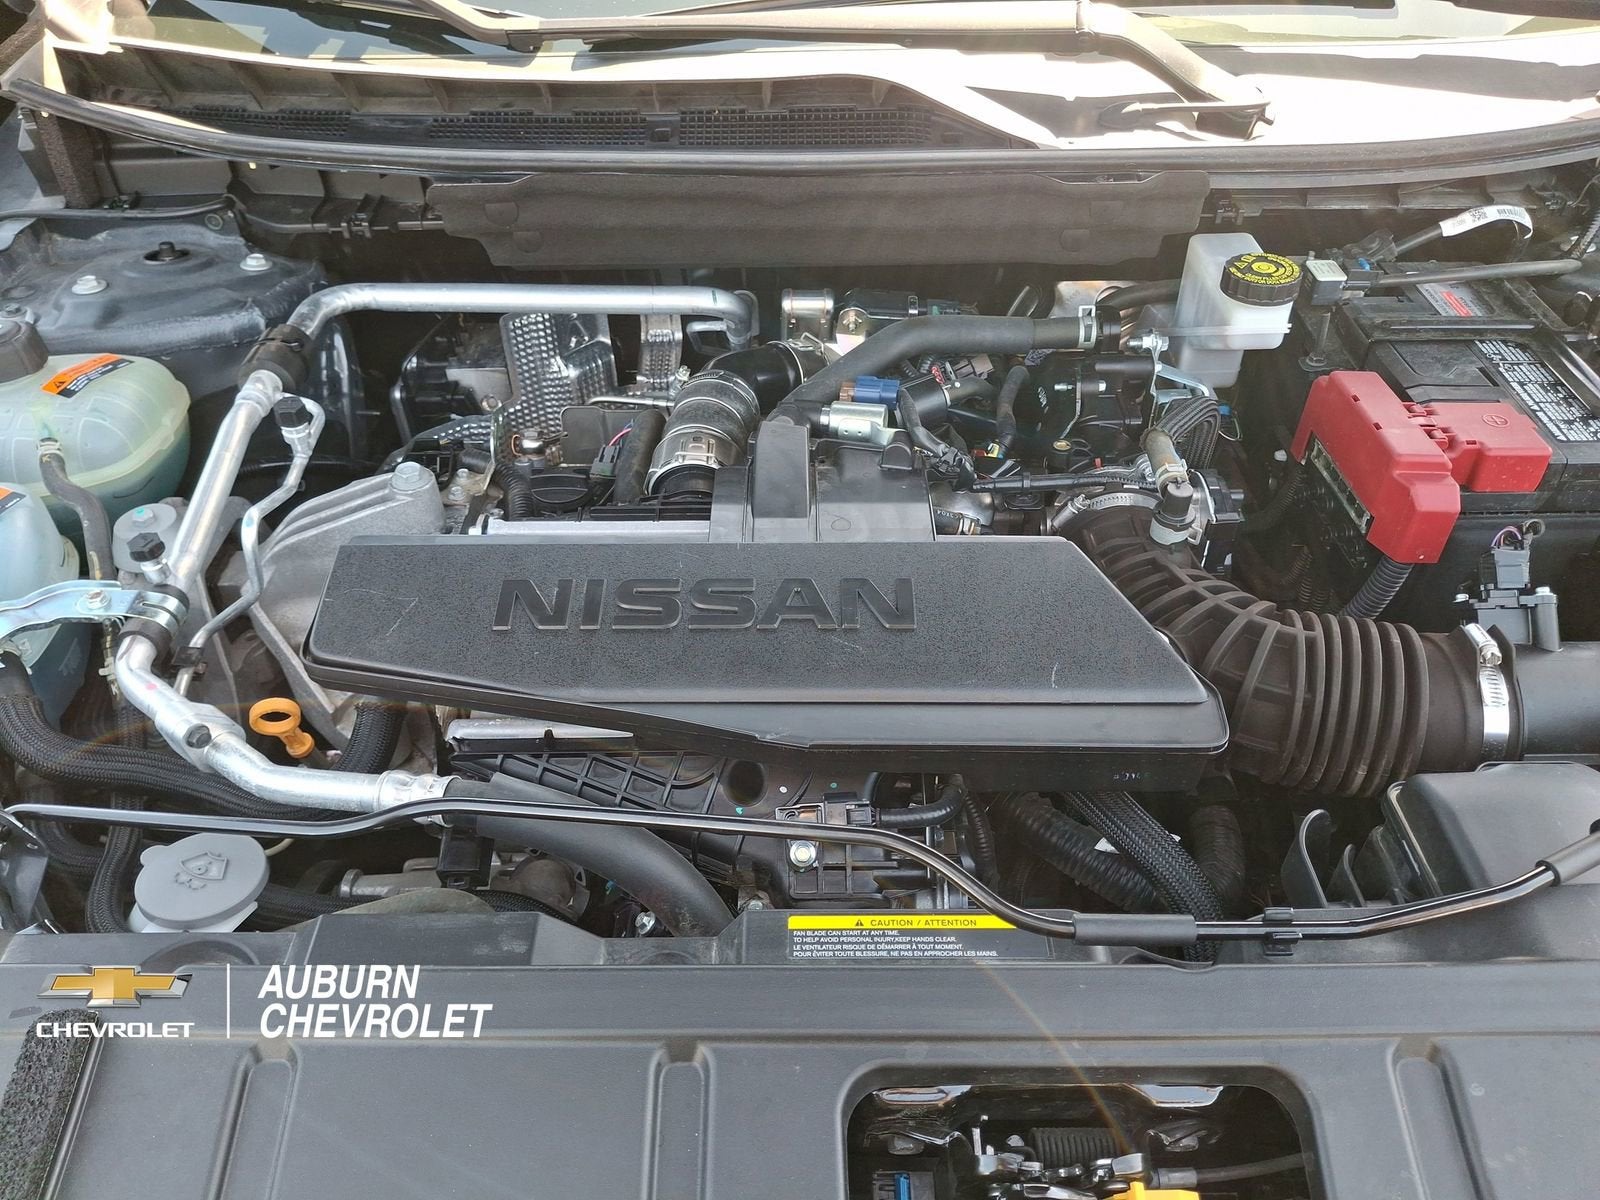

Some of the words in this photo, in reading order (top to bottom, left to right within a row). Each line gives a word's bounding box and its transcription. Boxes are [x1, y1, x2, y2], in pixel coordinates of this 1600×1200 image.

[491, 577, 917, 631] NISSAN
[870, 919, 914, 927] CAUTION
[924, 919, 977, 927] ATTENTION
